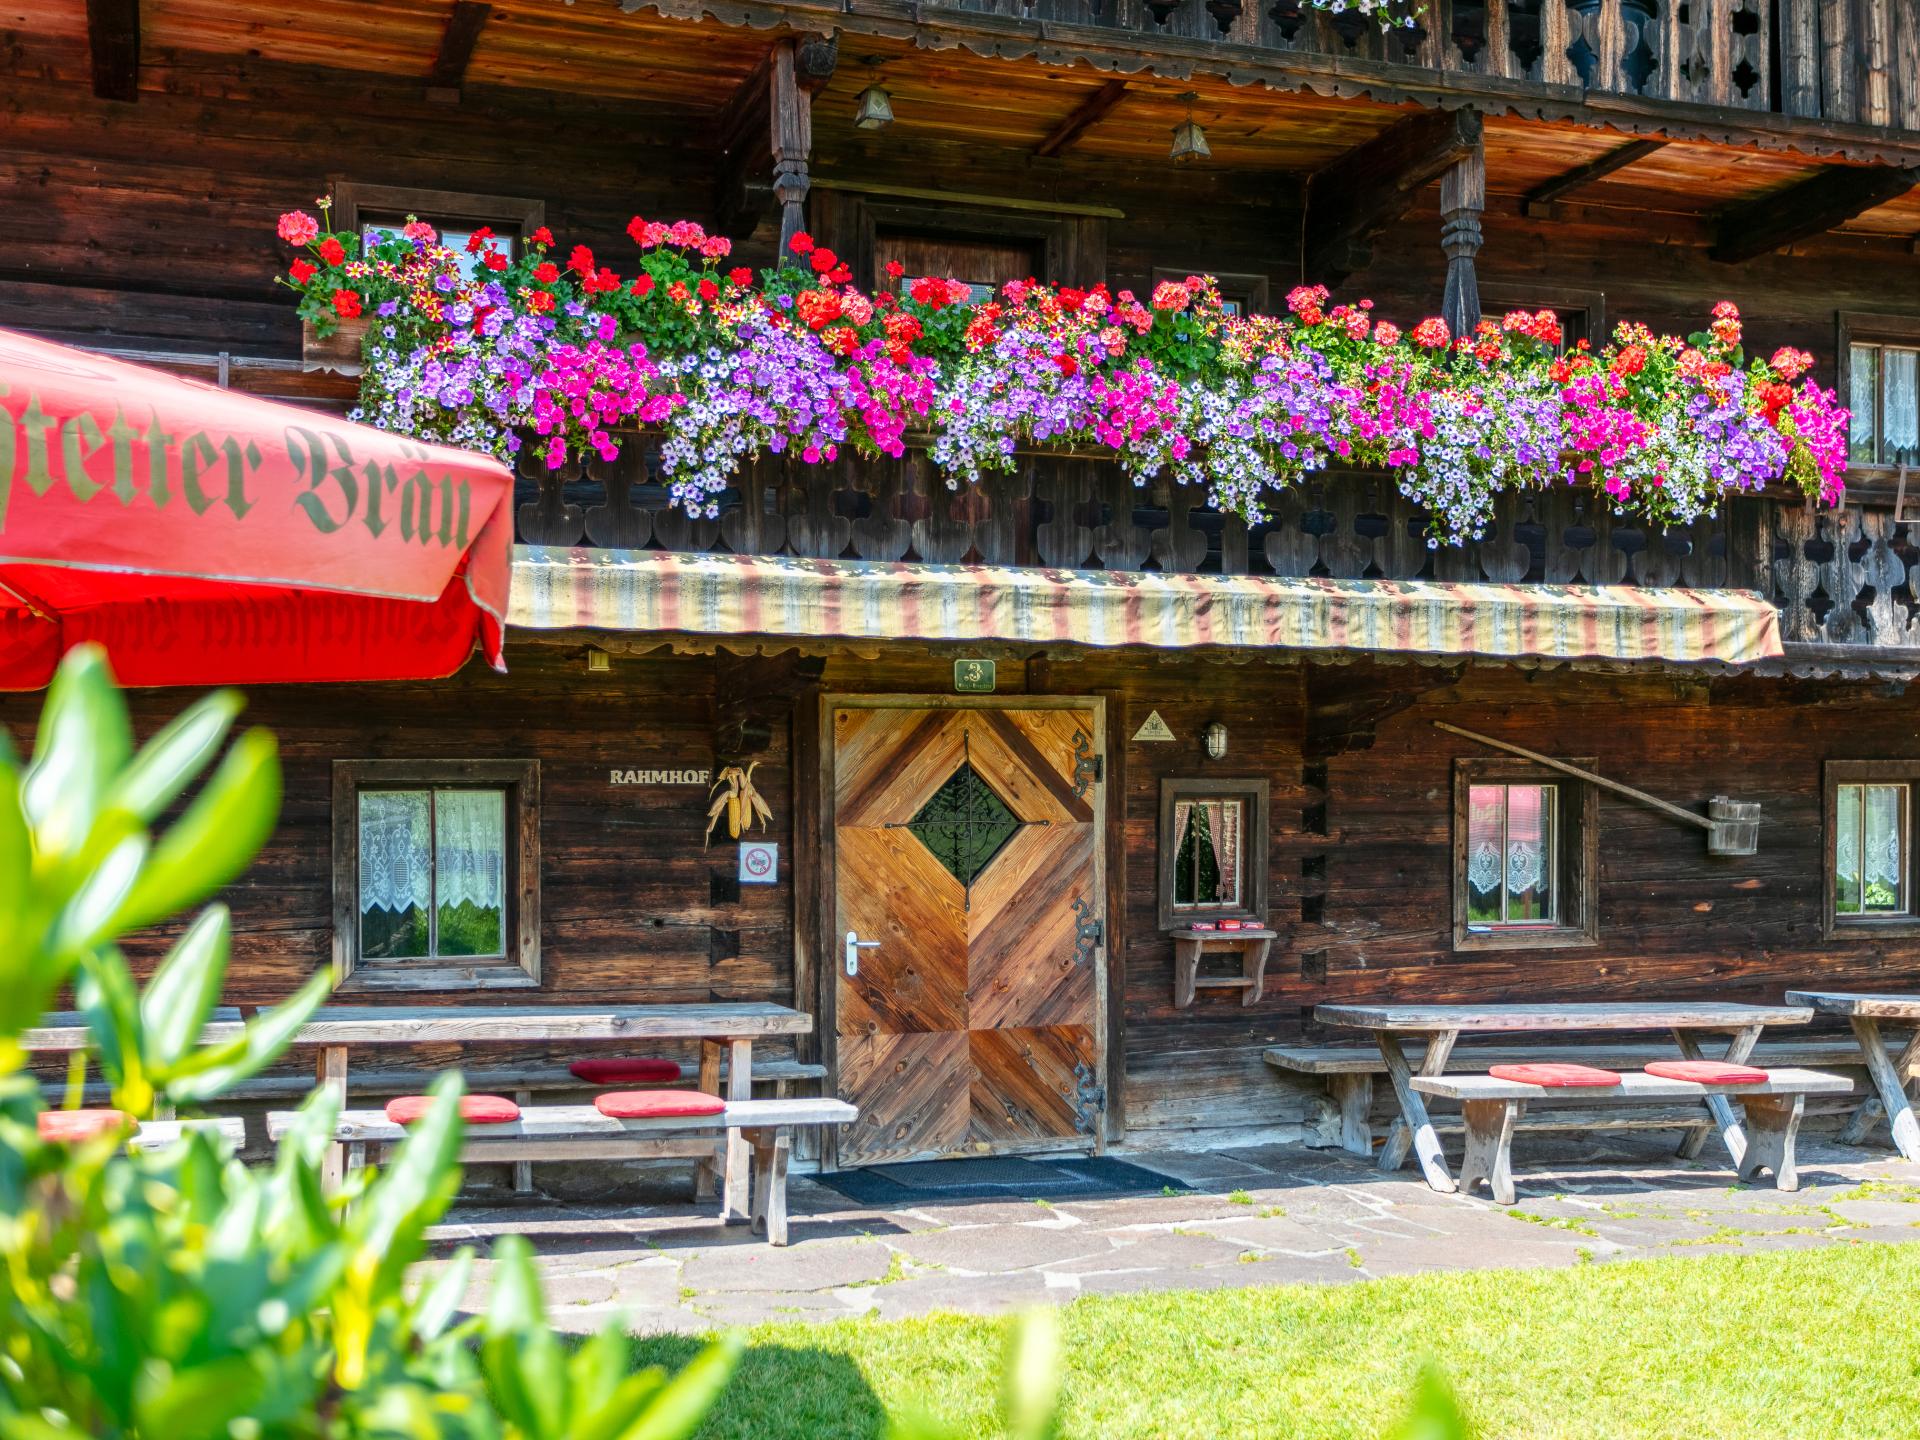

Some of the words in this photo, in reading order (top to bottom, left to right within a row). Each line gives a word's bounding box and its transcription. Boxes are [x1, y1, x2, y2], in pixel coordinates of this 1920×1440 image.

[284, 426, 472, 551] Bräu
[967, 662, 983, 682] 3
[609, 769, 710, 784] RAHMHOF
